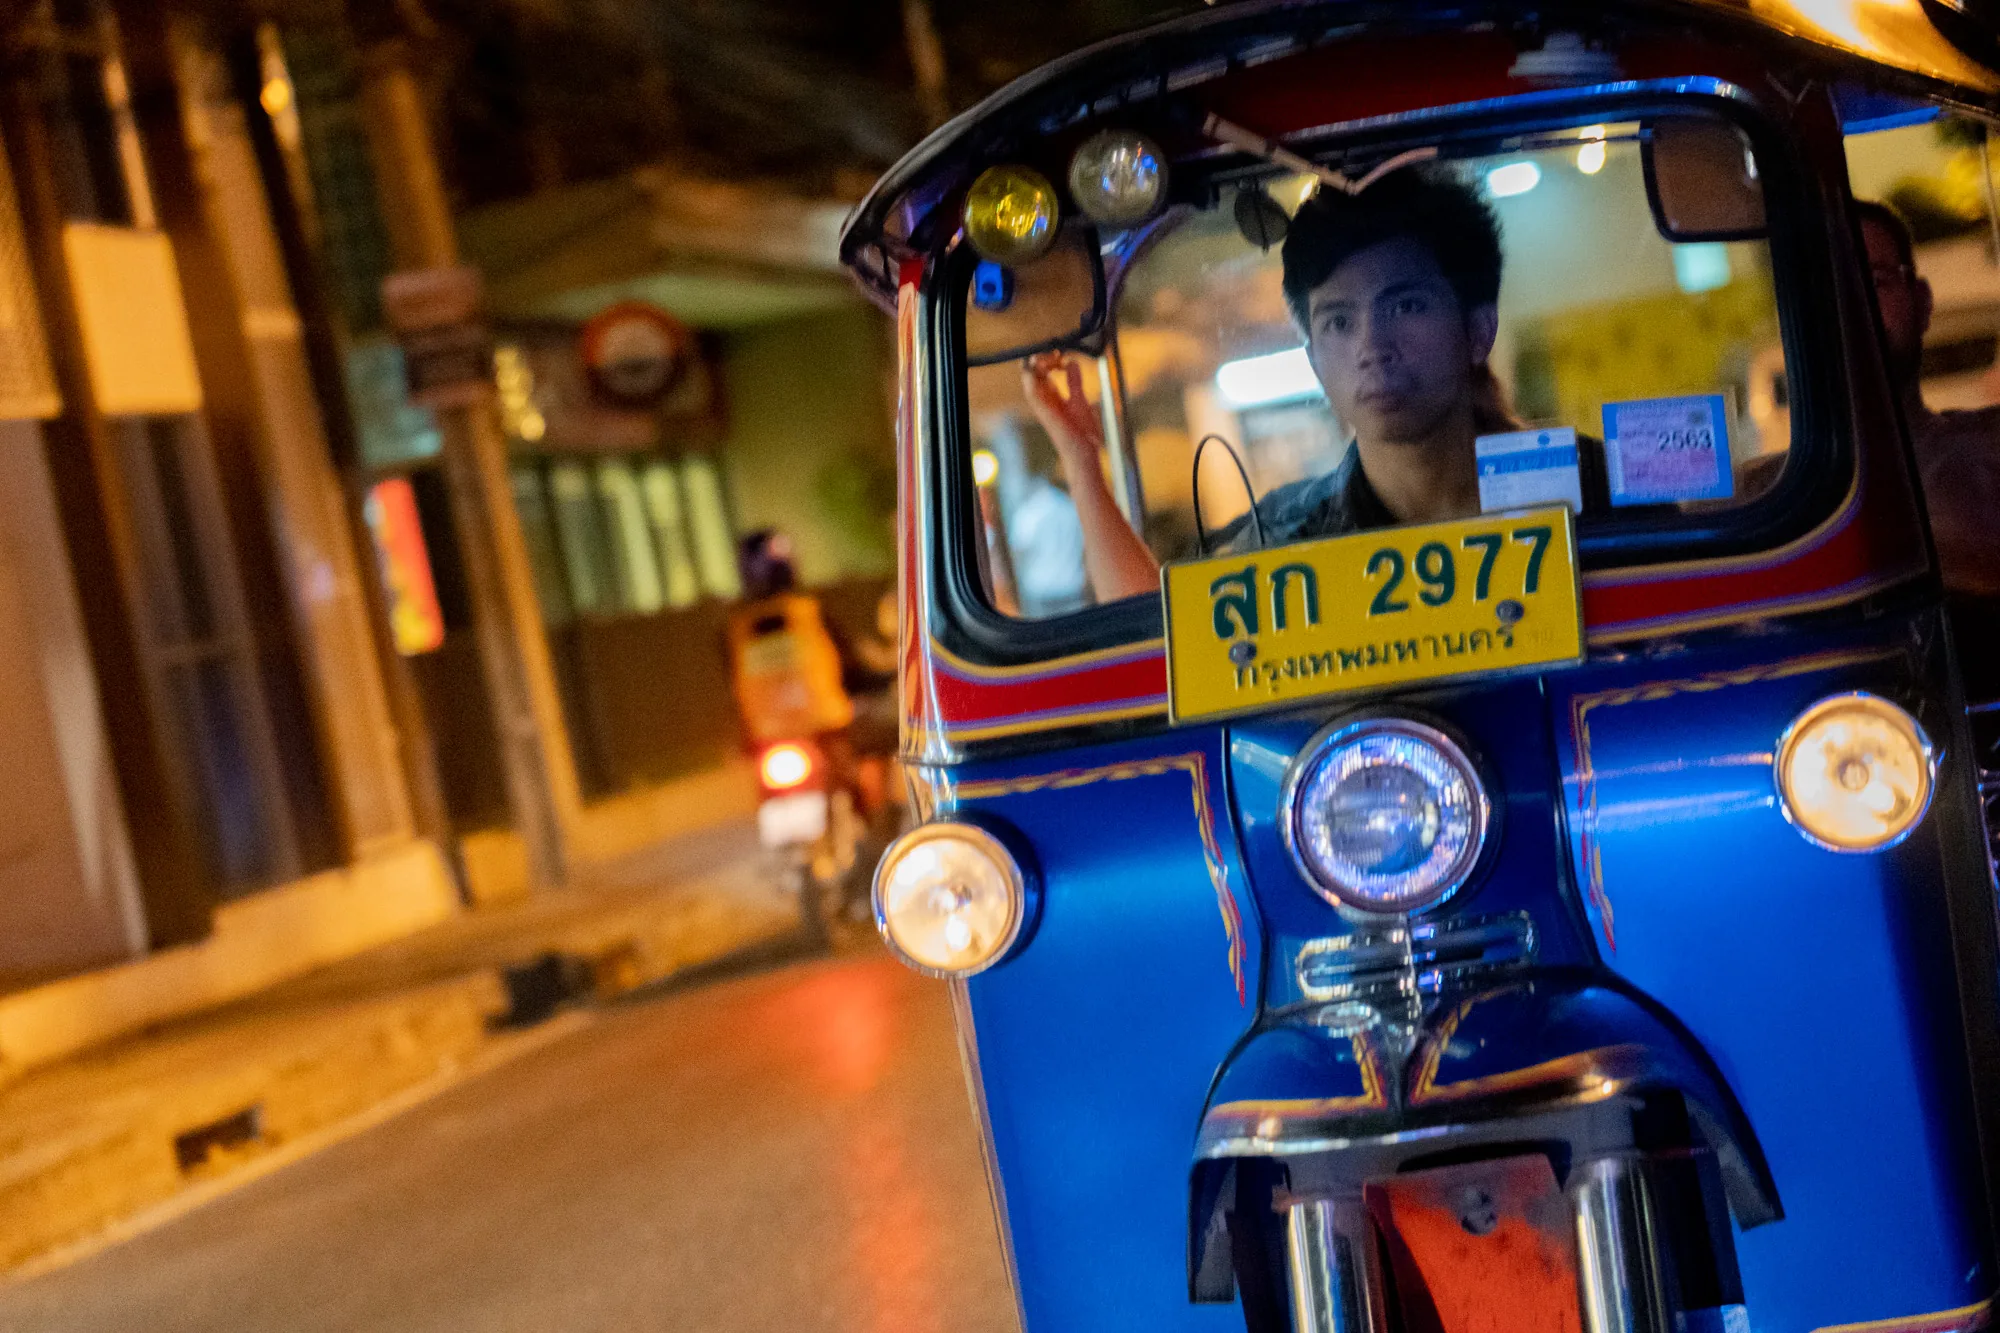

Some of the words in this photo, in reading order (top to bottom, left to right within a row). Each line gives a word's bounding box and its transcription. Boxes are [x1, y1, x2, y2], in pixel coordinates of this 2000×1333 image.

[1657, 430, 1713, 452] 2563
[1209, 565, 1319, 640] สก
[1363, 526, 1552, 616] 2977
